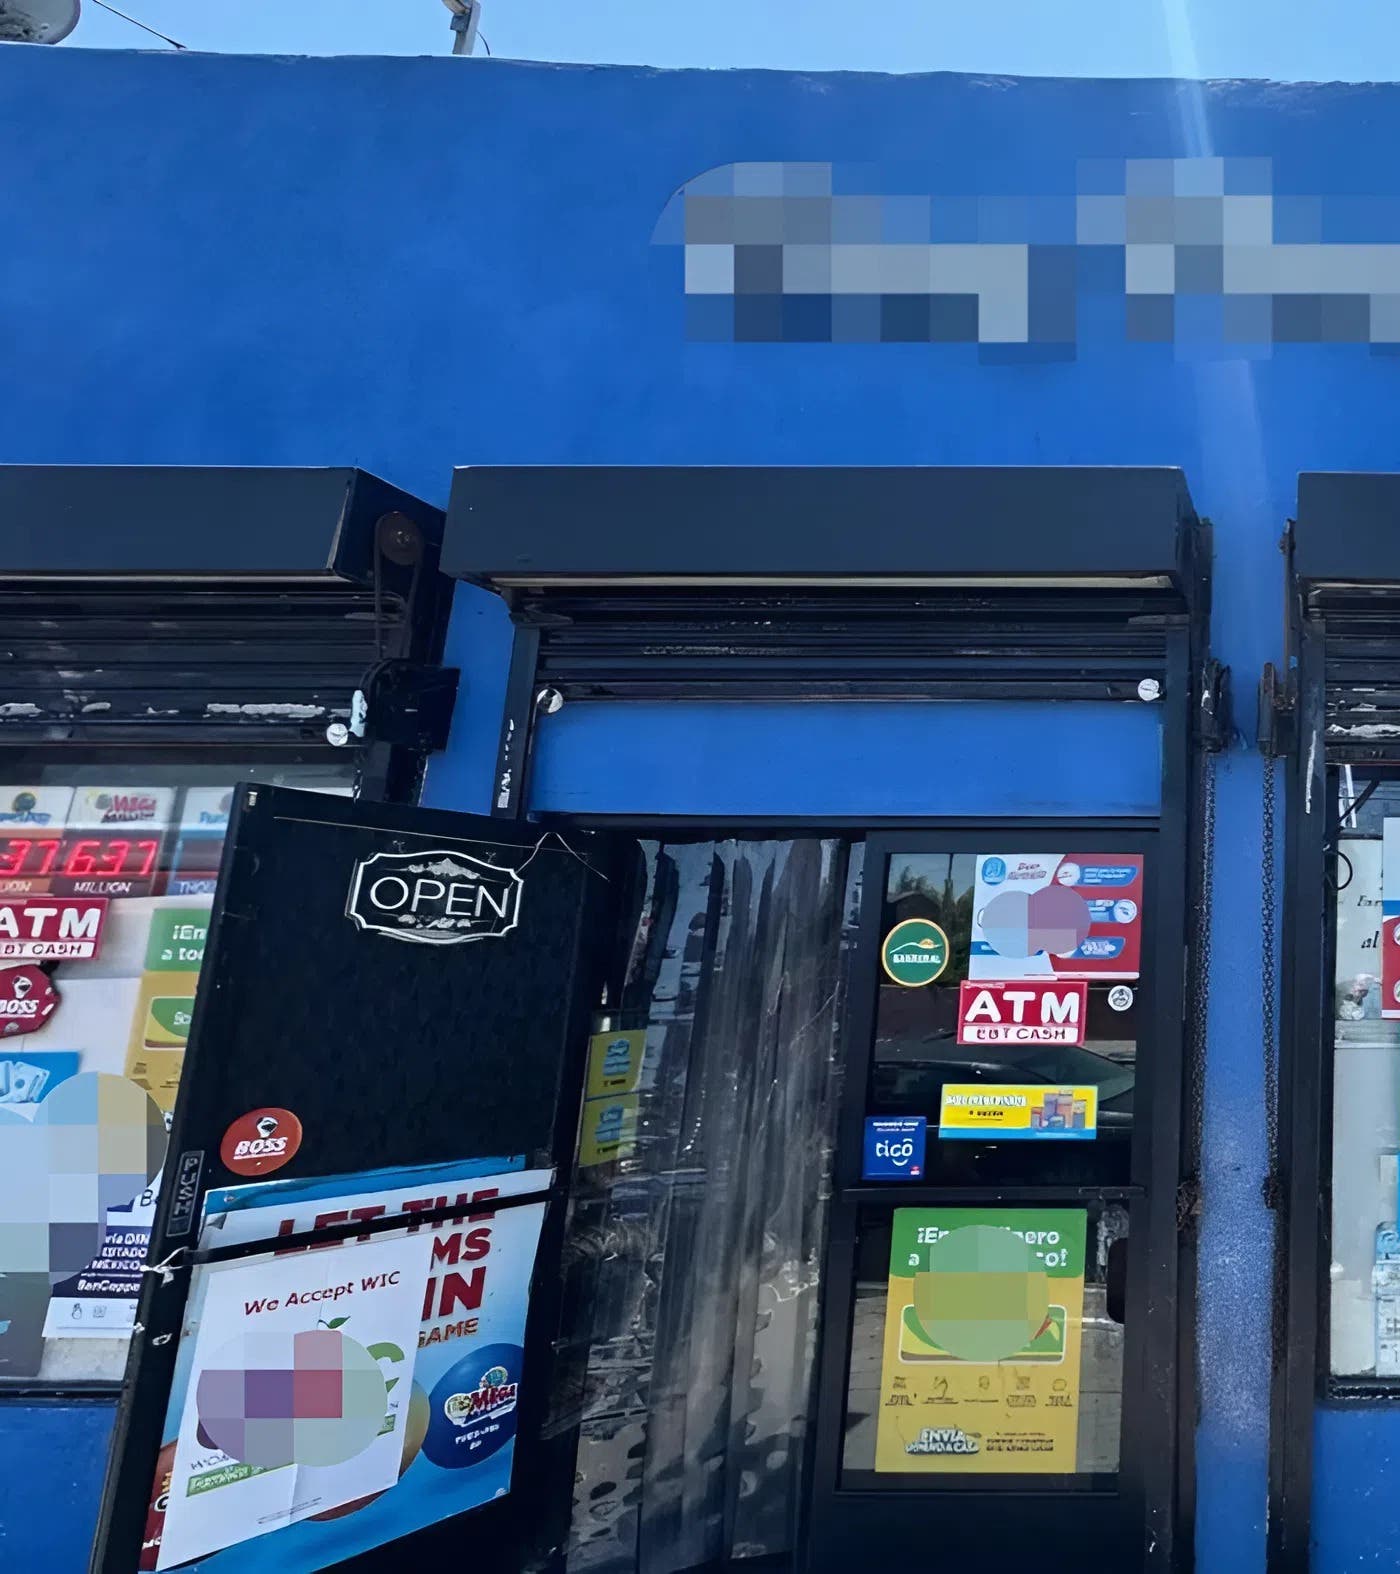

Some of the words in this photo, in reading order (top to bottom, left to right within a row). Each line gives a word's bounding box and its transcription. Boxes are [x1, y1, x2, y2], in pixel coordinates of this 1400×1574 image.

[74, 881, 132, 893] MILLION
[370, 876, 508, 918] OPEN
[964, 990, 1080, 1024] ATM
[1016, 1028, 1066, 1041] CASH
[235, 1137, 288, 1156] BOSS
[285, 1281, 354, 1308] Accept
[361, 1270, 401, 1291] WIC
